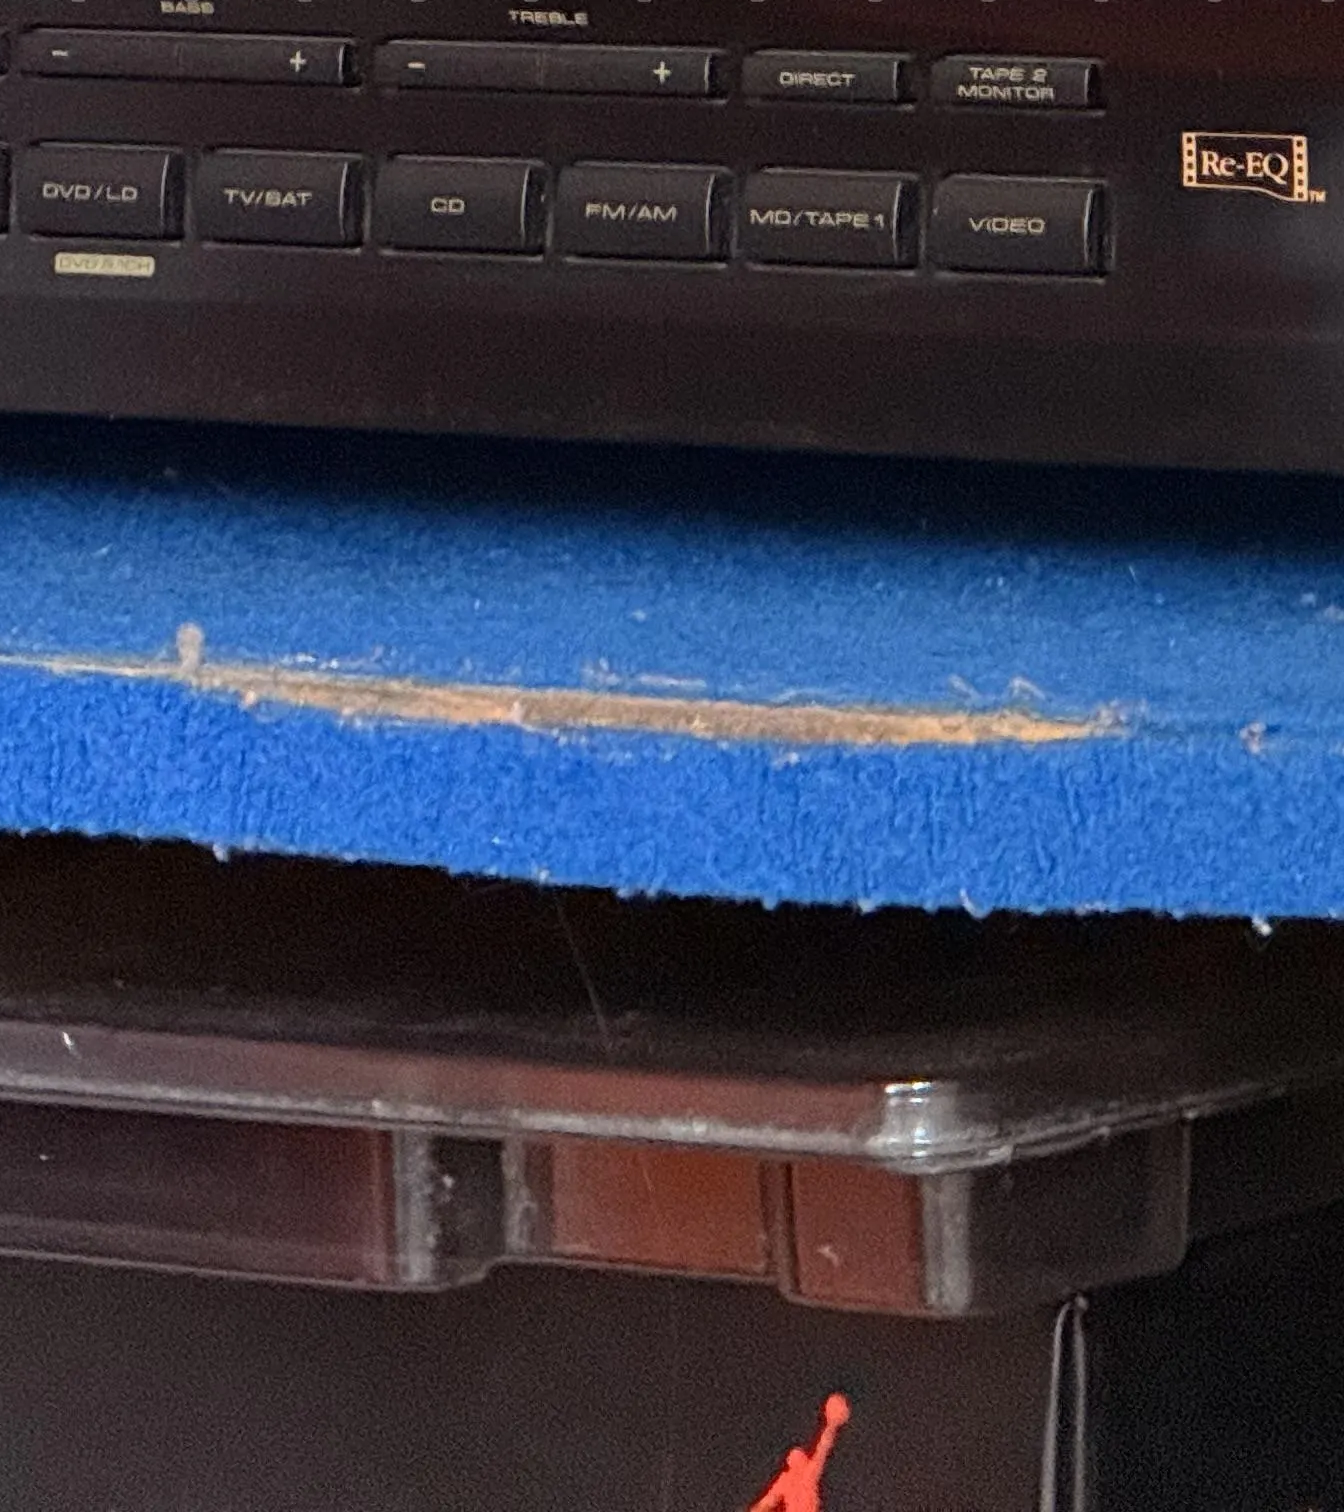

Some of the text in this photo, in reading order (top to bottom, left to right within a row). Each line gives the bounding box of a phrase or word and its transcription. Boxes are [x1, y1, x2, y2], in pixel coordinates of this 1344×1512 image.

[160, 0, 215, 15] BASS
[508, 9, 588, 26] TREBLE
[778, 71, 856, 87] DIRECT
[968, 66, 1026, 82] TAPE
[957, 84, 1055, 101] MONITOR
[1201, 150, 1289, 185] Re-EQ
[42, 182, 138, 202] DVD/LD
[223, 188, 313, 207] TV/SAT
[430, 197, 466, 215] CD
[585, 202, 677, 222] FM/AM
[968, 216, 1046, 235] VIDEO
